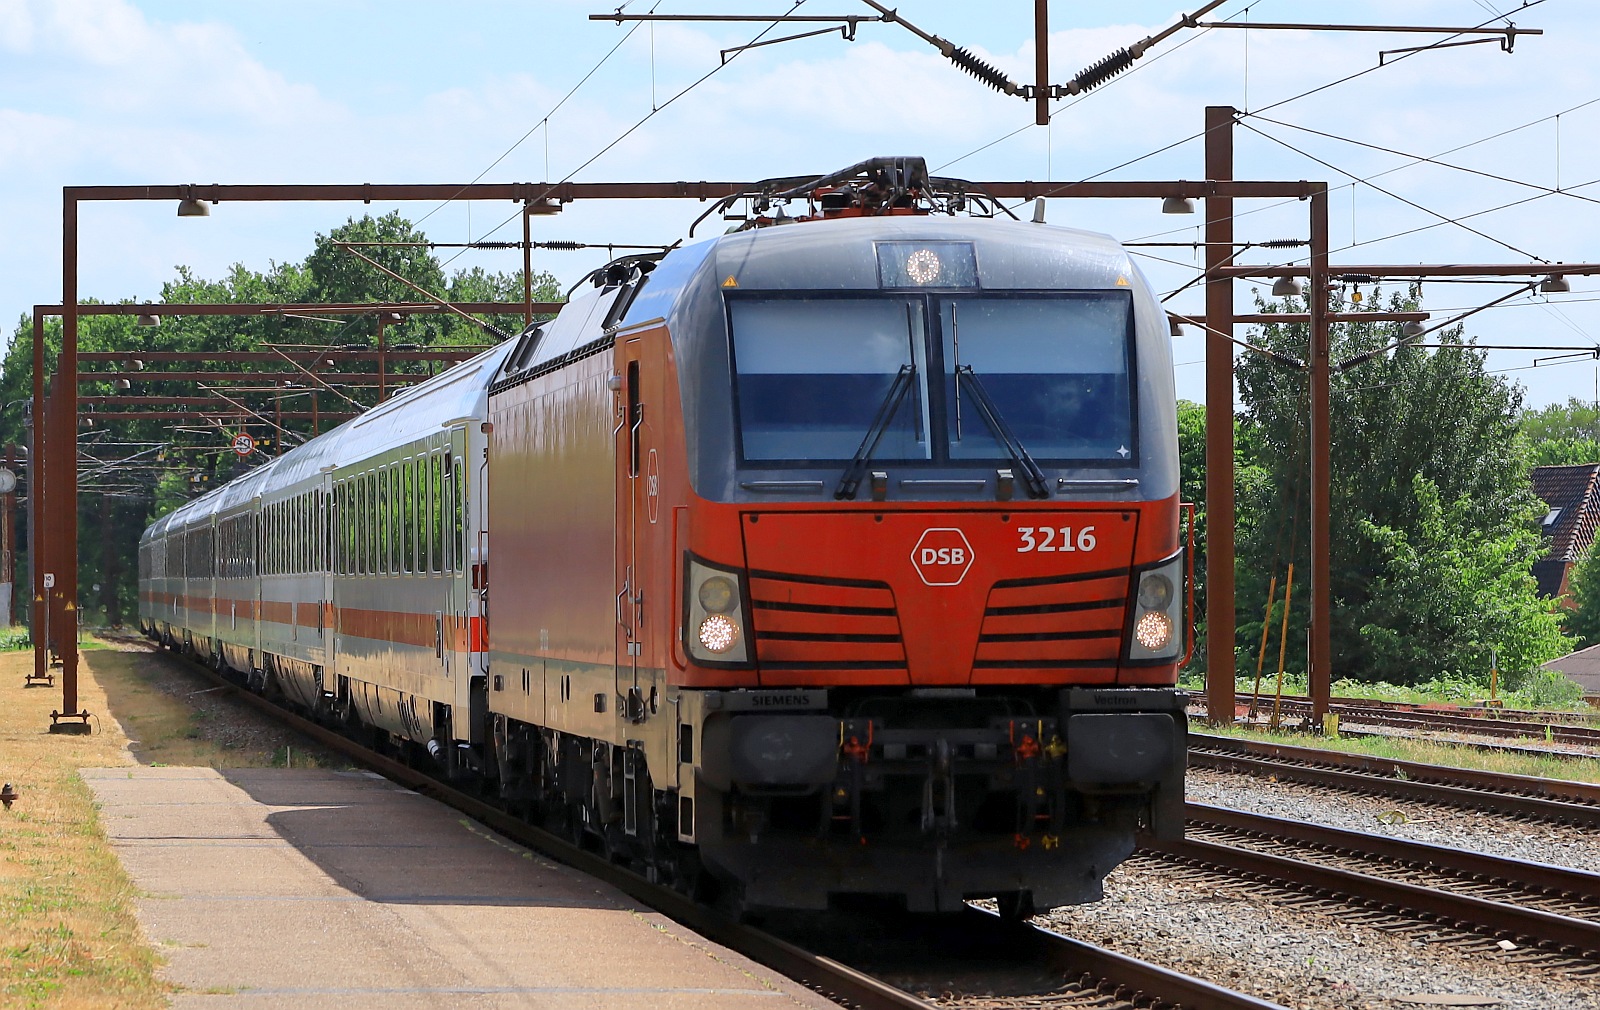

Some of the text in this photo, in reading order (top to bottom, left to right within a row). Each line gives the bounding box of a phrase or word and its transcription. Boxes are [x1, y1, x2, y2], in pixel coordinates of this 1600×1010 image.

[649, 475, 657, 496] DSB
[1016, 525, 1097, 553] 3216
[921, 548, 965, 566] DSB
[752, 695, 810, 706] SIEMENS
[1094, 695, 1137, 705] Vectron
